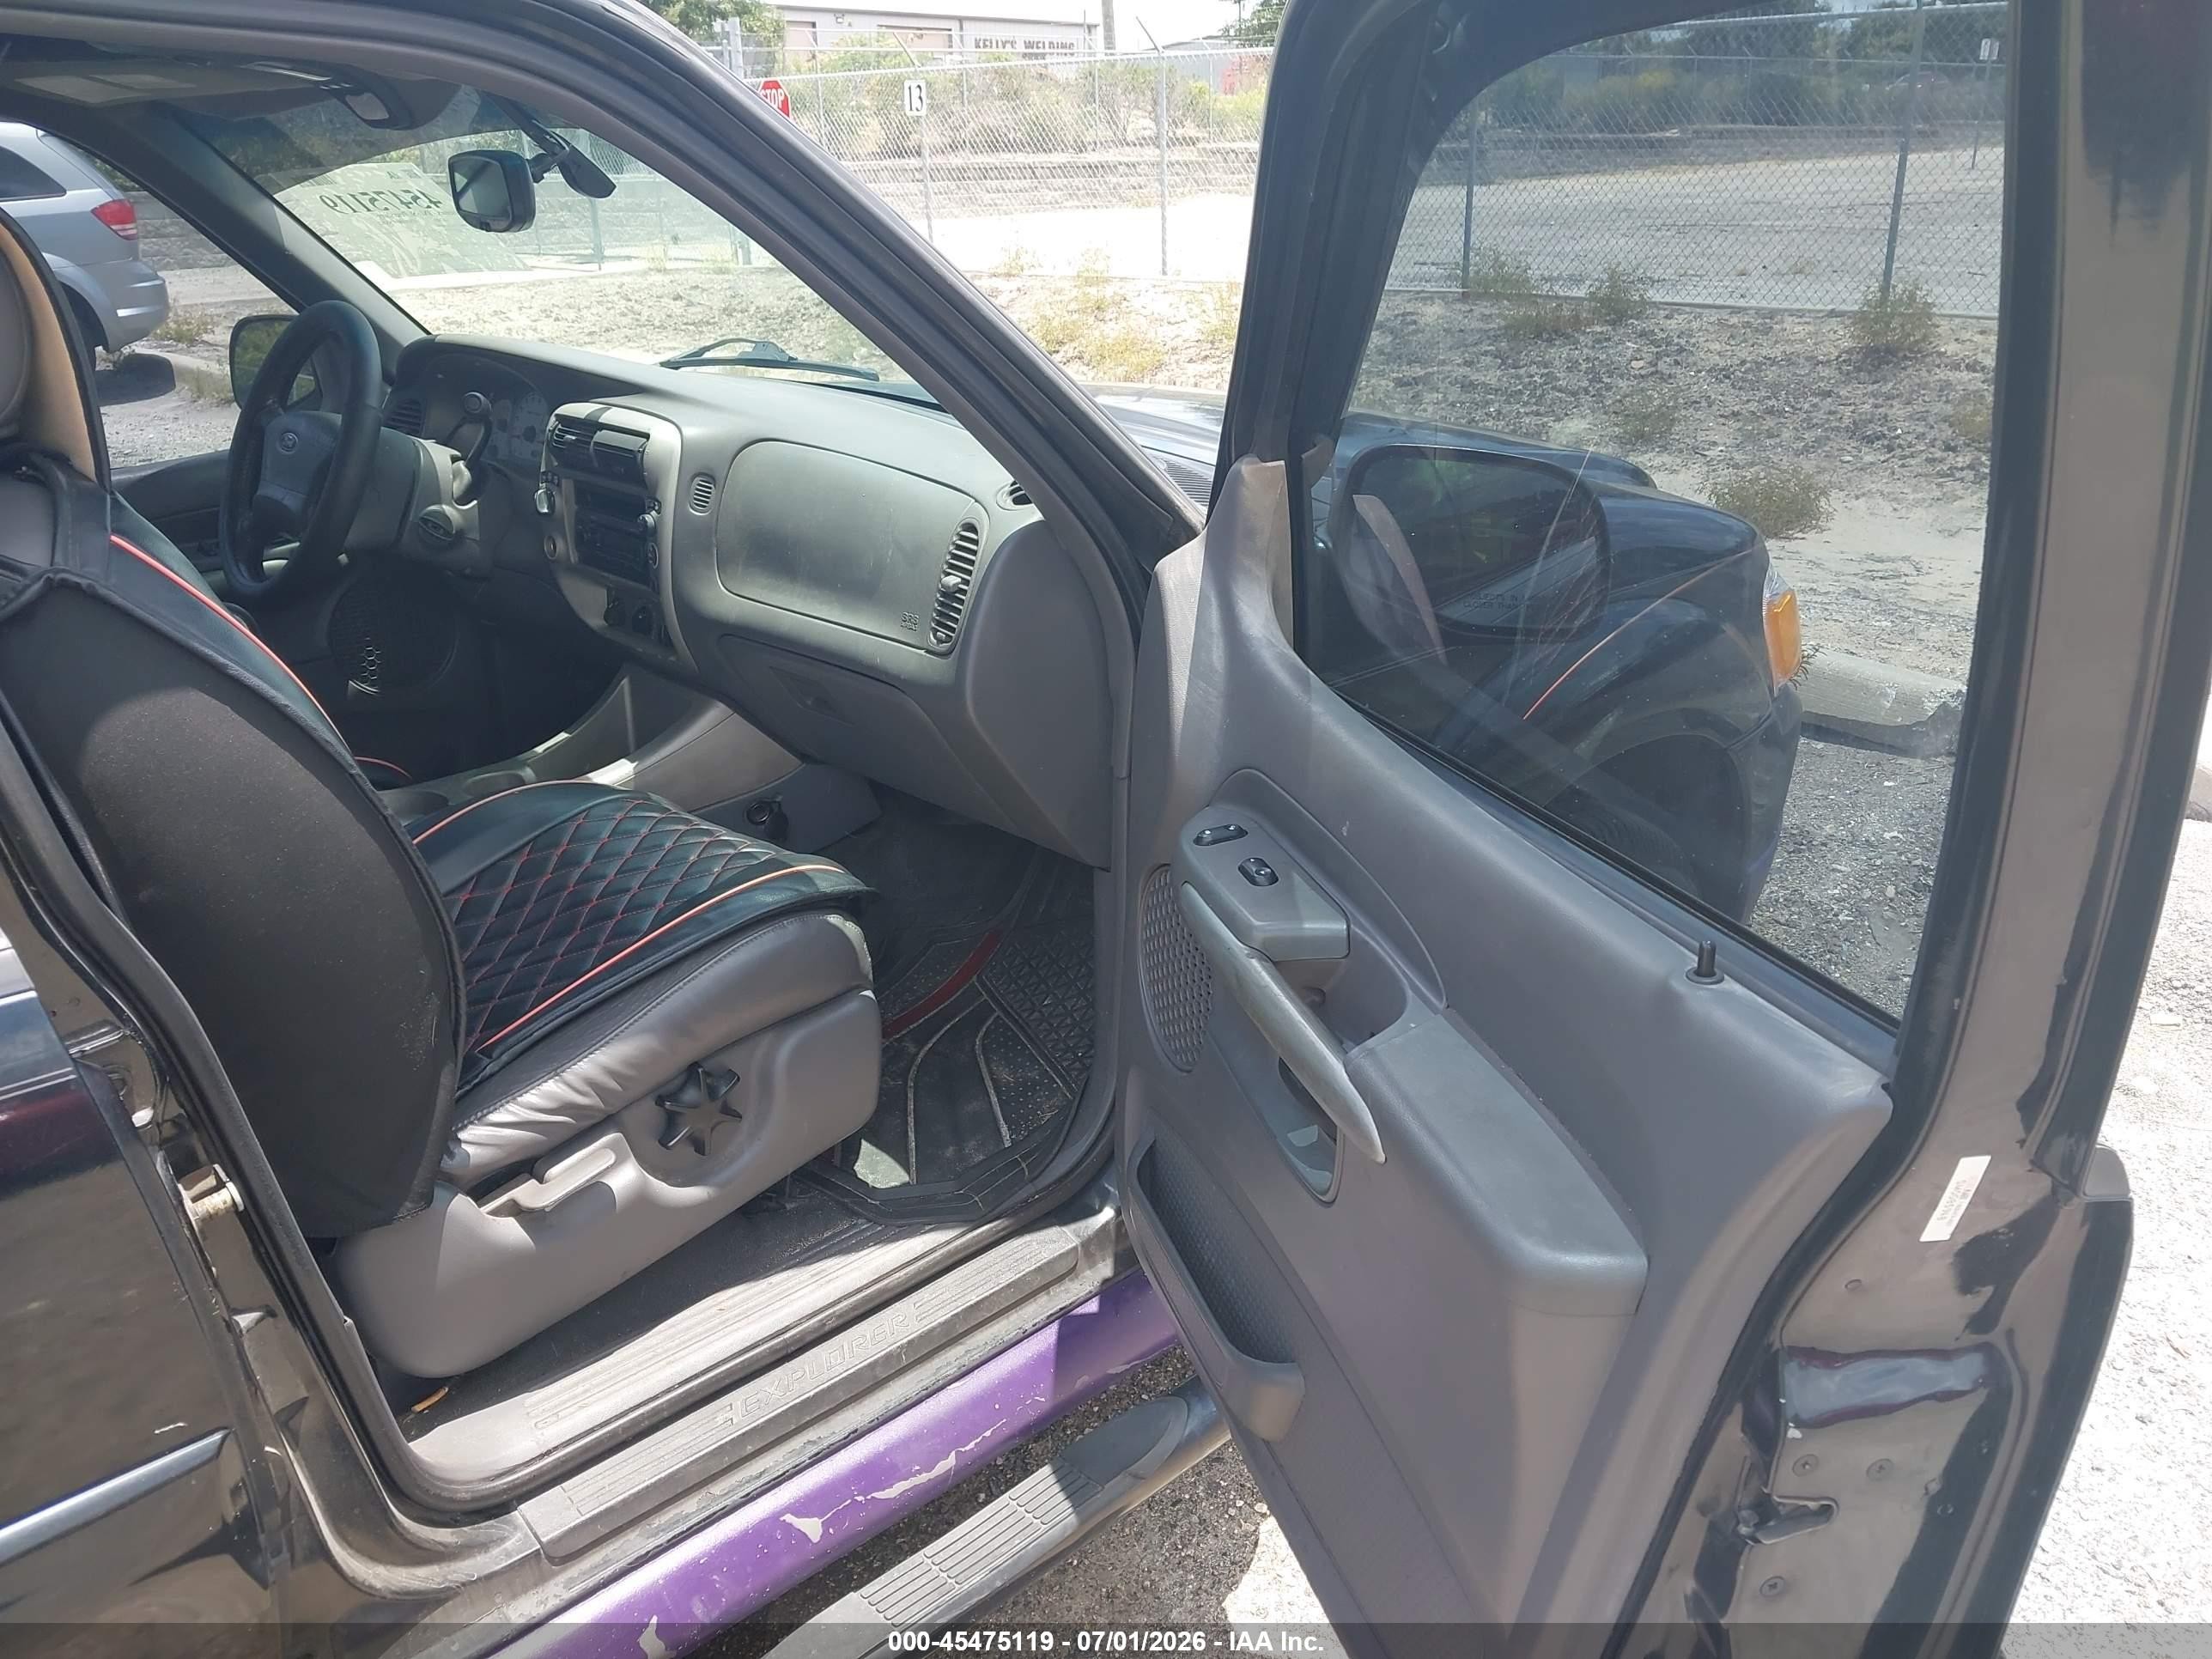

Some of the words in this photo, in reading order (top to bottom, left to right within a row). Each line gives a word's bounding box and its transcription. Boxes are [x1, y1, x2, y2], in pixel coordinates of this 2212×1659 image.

[1023, 39, 1075, 55] WELDING
[760, 88, 785, 108] STOP
[907, 83, 924, 112] 13
[739, 1312, 909, 1419] EXPLORER
